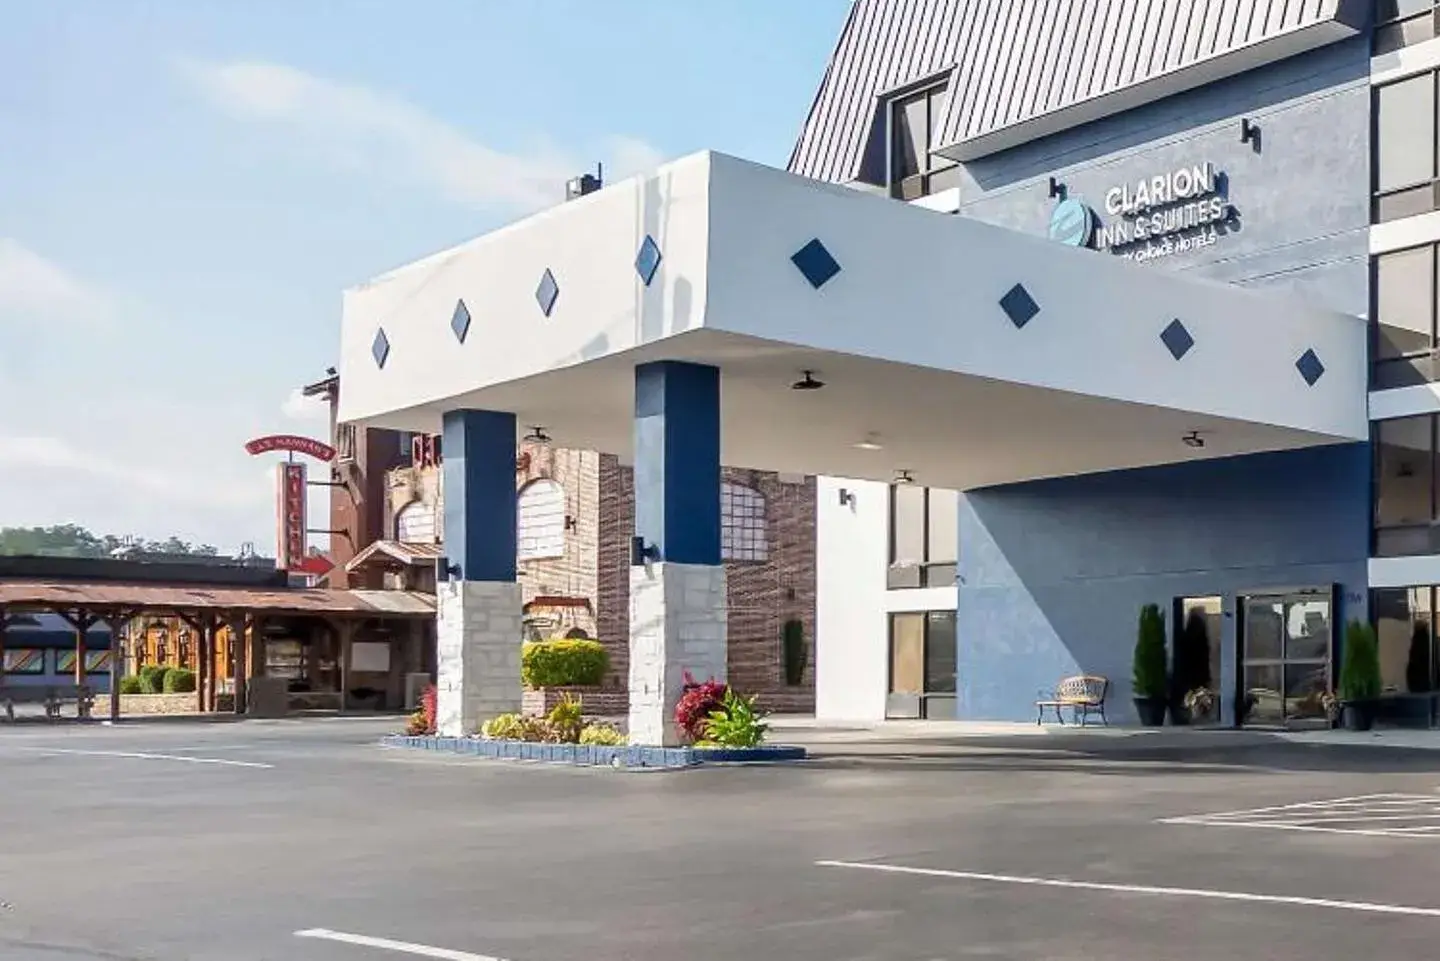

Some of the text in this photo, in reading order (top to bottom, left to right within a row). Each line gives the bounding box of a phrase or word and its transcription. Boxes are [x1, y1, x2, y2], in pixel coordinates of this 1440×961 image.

[1105, 162, 1214, 215] CLARION
[1096, 196, 1222, 248] INN & SUITES
[1175, 232, 1216, 253] HOTELS
[288, 466, 302, 567] KITCHEN
